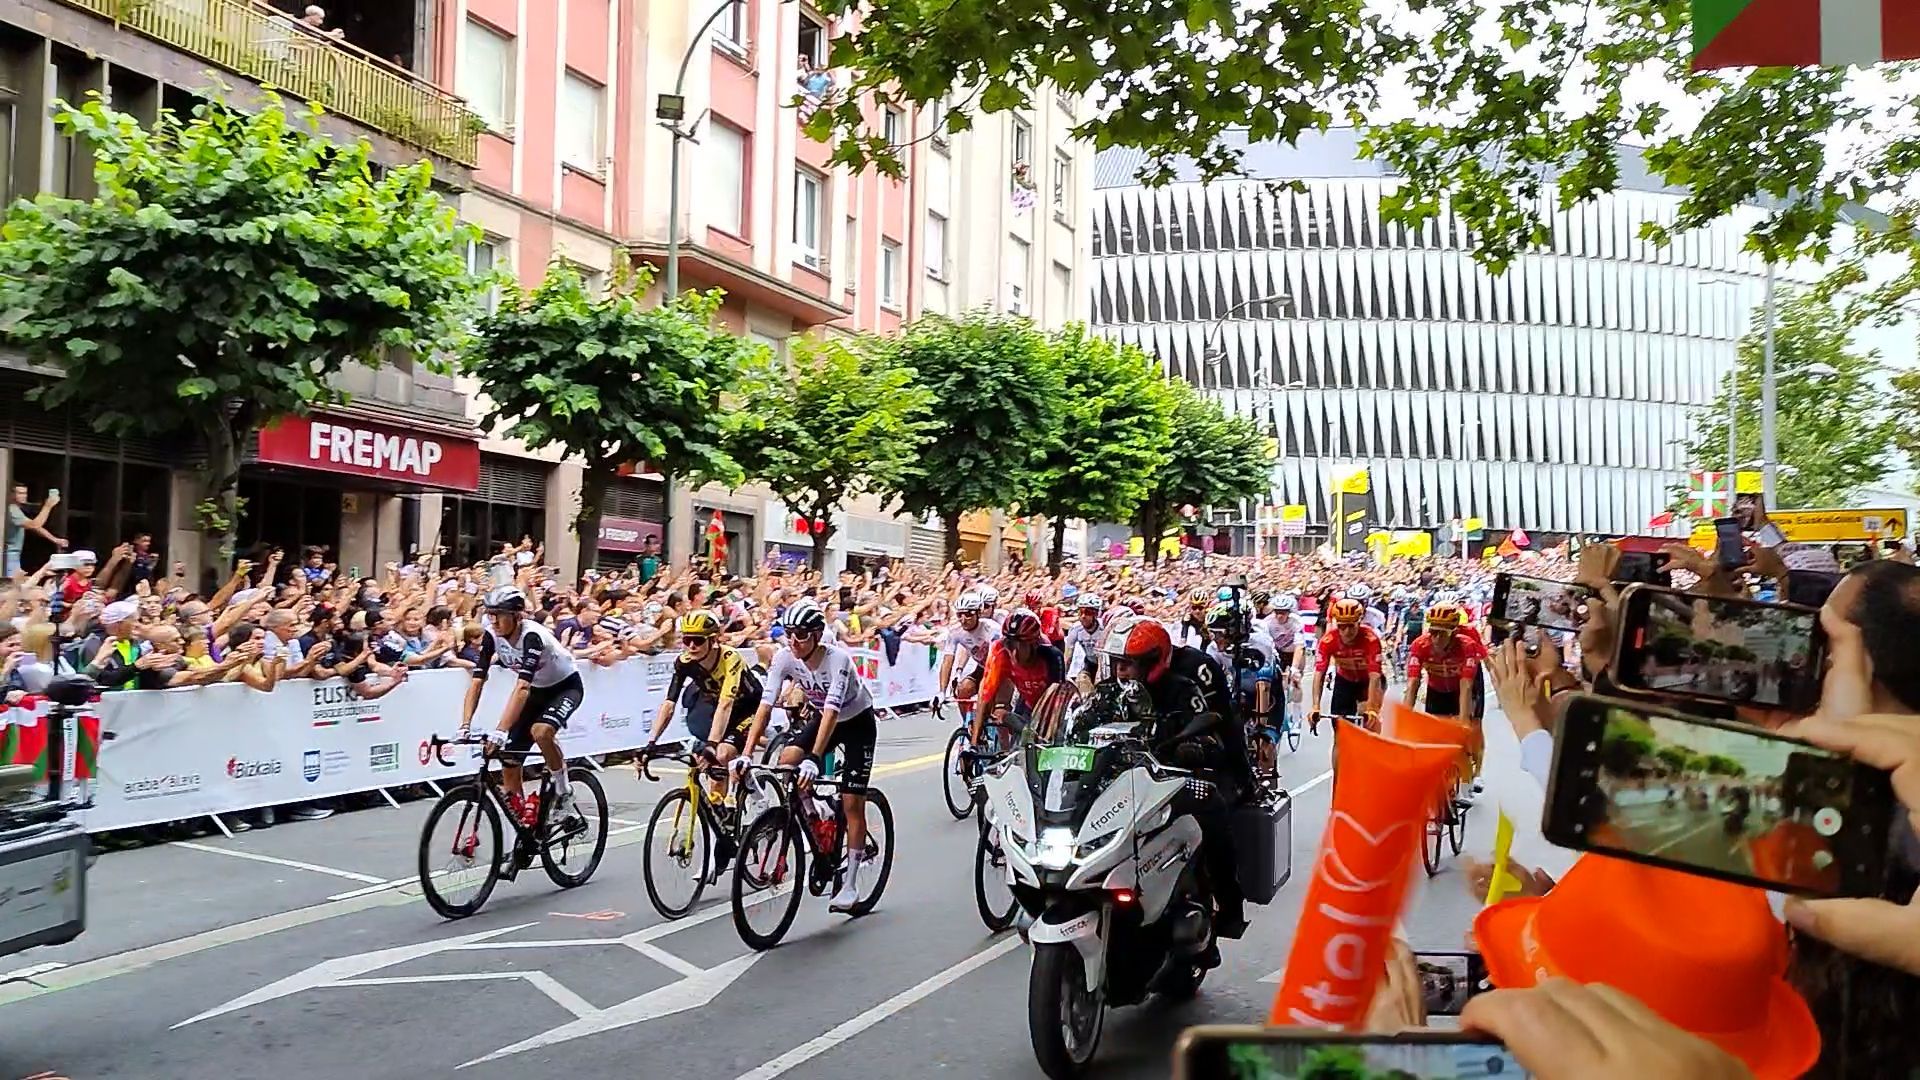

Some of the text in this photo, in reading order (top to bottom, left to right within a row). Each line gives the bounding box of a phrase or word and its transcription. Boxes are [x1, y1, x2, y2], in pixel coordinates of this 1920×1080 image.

[309, 421, 443, 476] FREMAP
[313, 685, 358, 706] EUSK
[234, 759, 282, 779] Bizkaia
[1004, 791, 1022, 823] france
[1090, 799, 1124, 832] france
[1060, 920, 1086, 937] france
